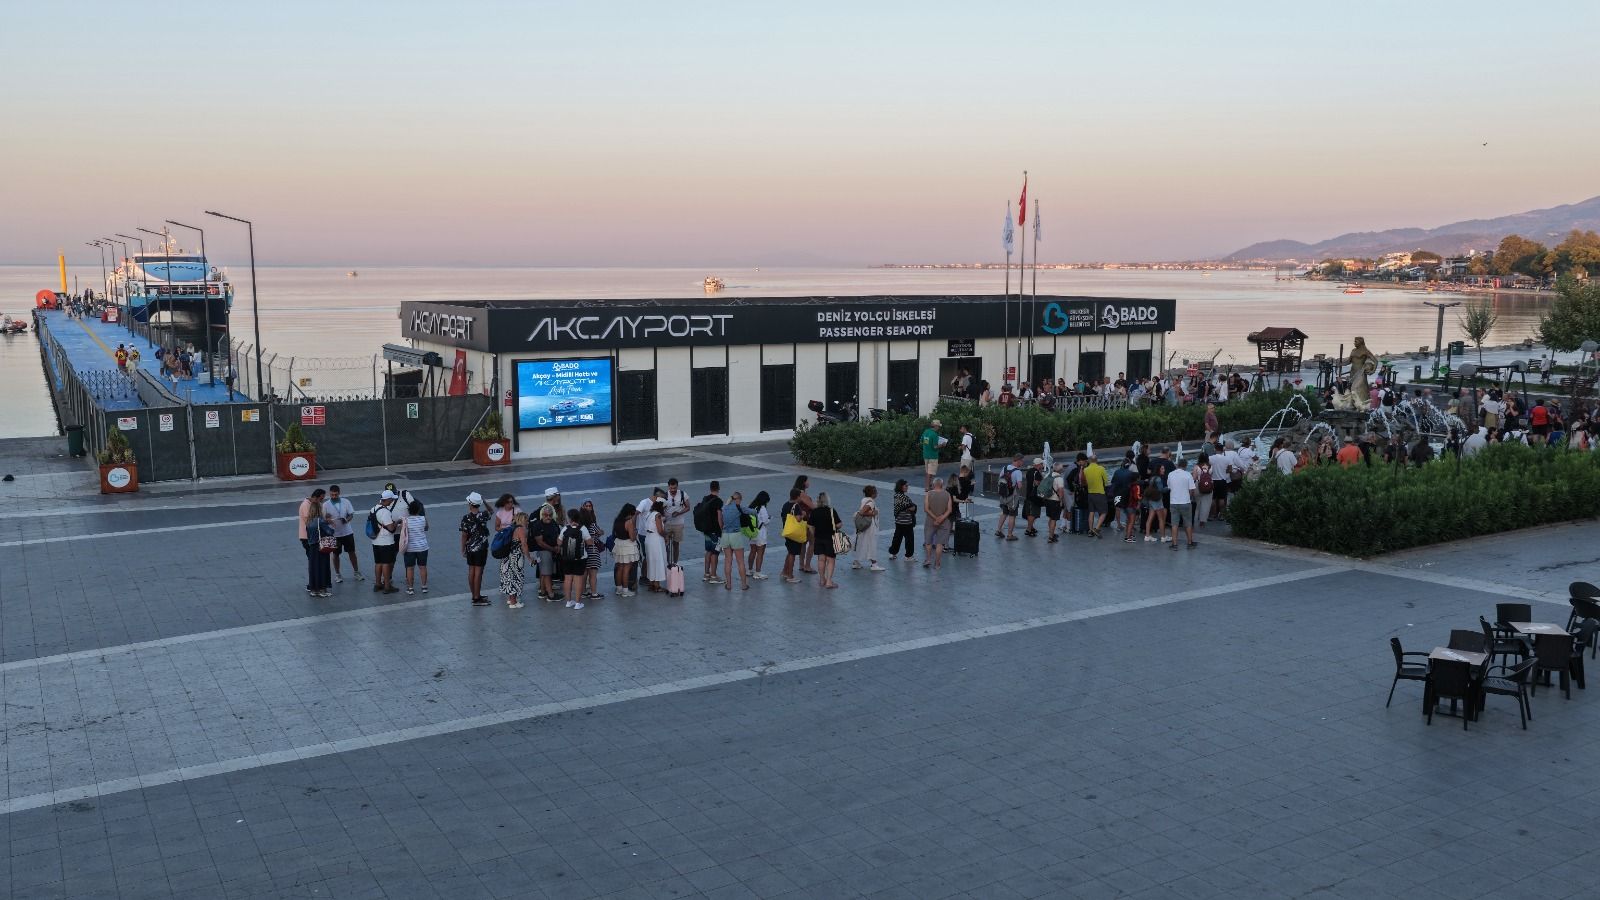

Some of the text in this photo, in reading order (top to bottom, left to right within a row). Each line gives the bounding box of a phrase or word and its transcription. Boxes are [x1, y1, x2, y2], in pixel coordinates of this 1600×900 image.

[817, 308, 936, 322] DENİZ YOLCU İSKELESİ
[1120, 306, 1158, 321] BADO
[819, 325, 934, 338] PASSENGER SEAPORT
